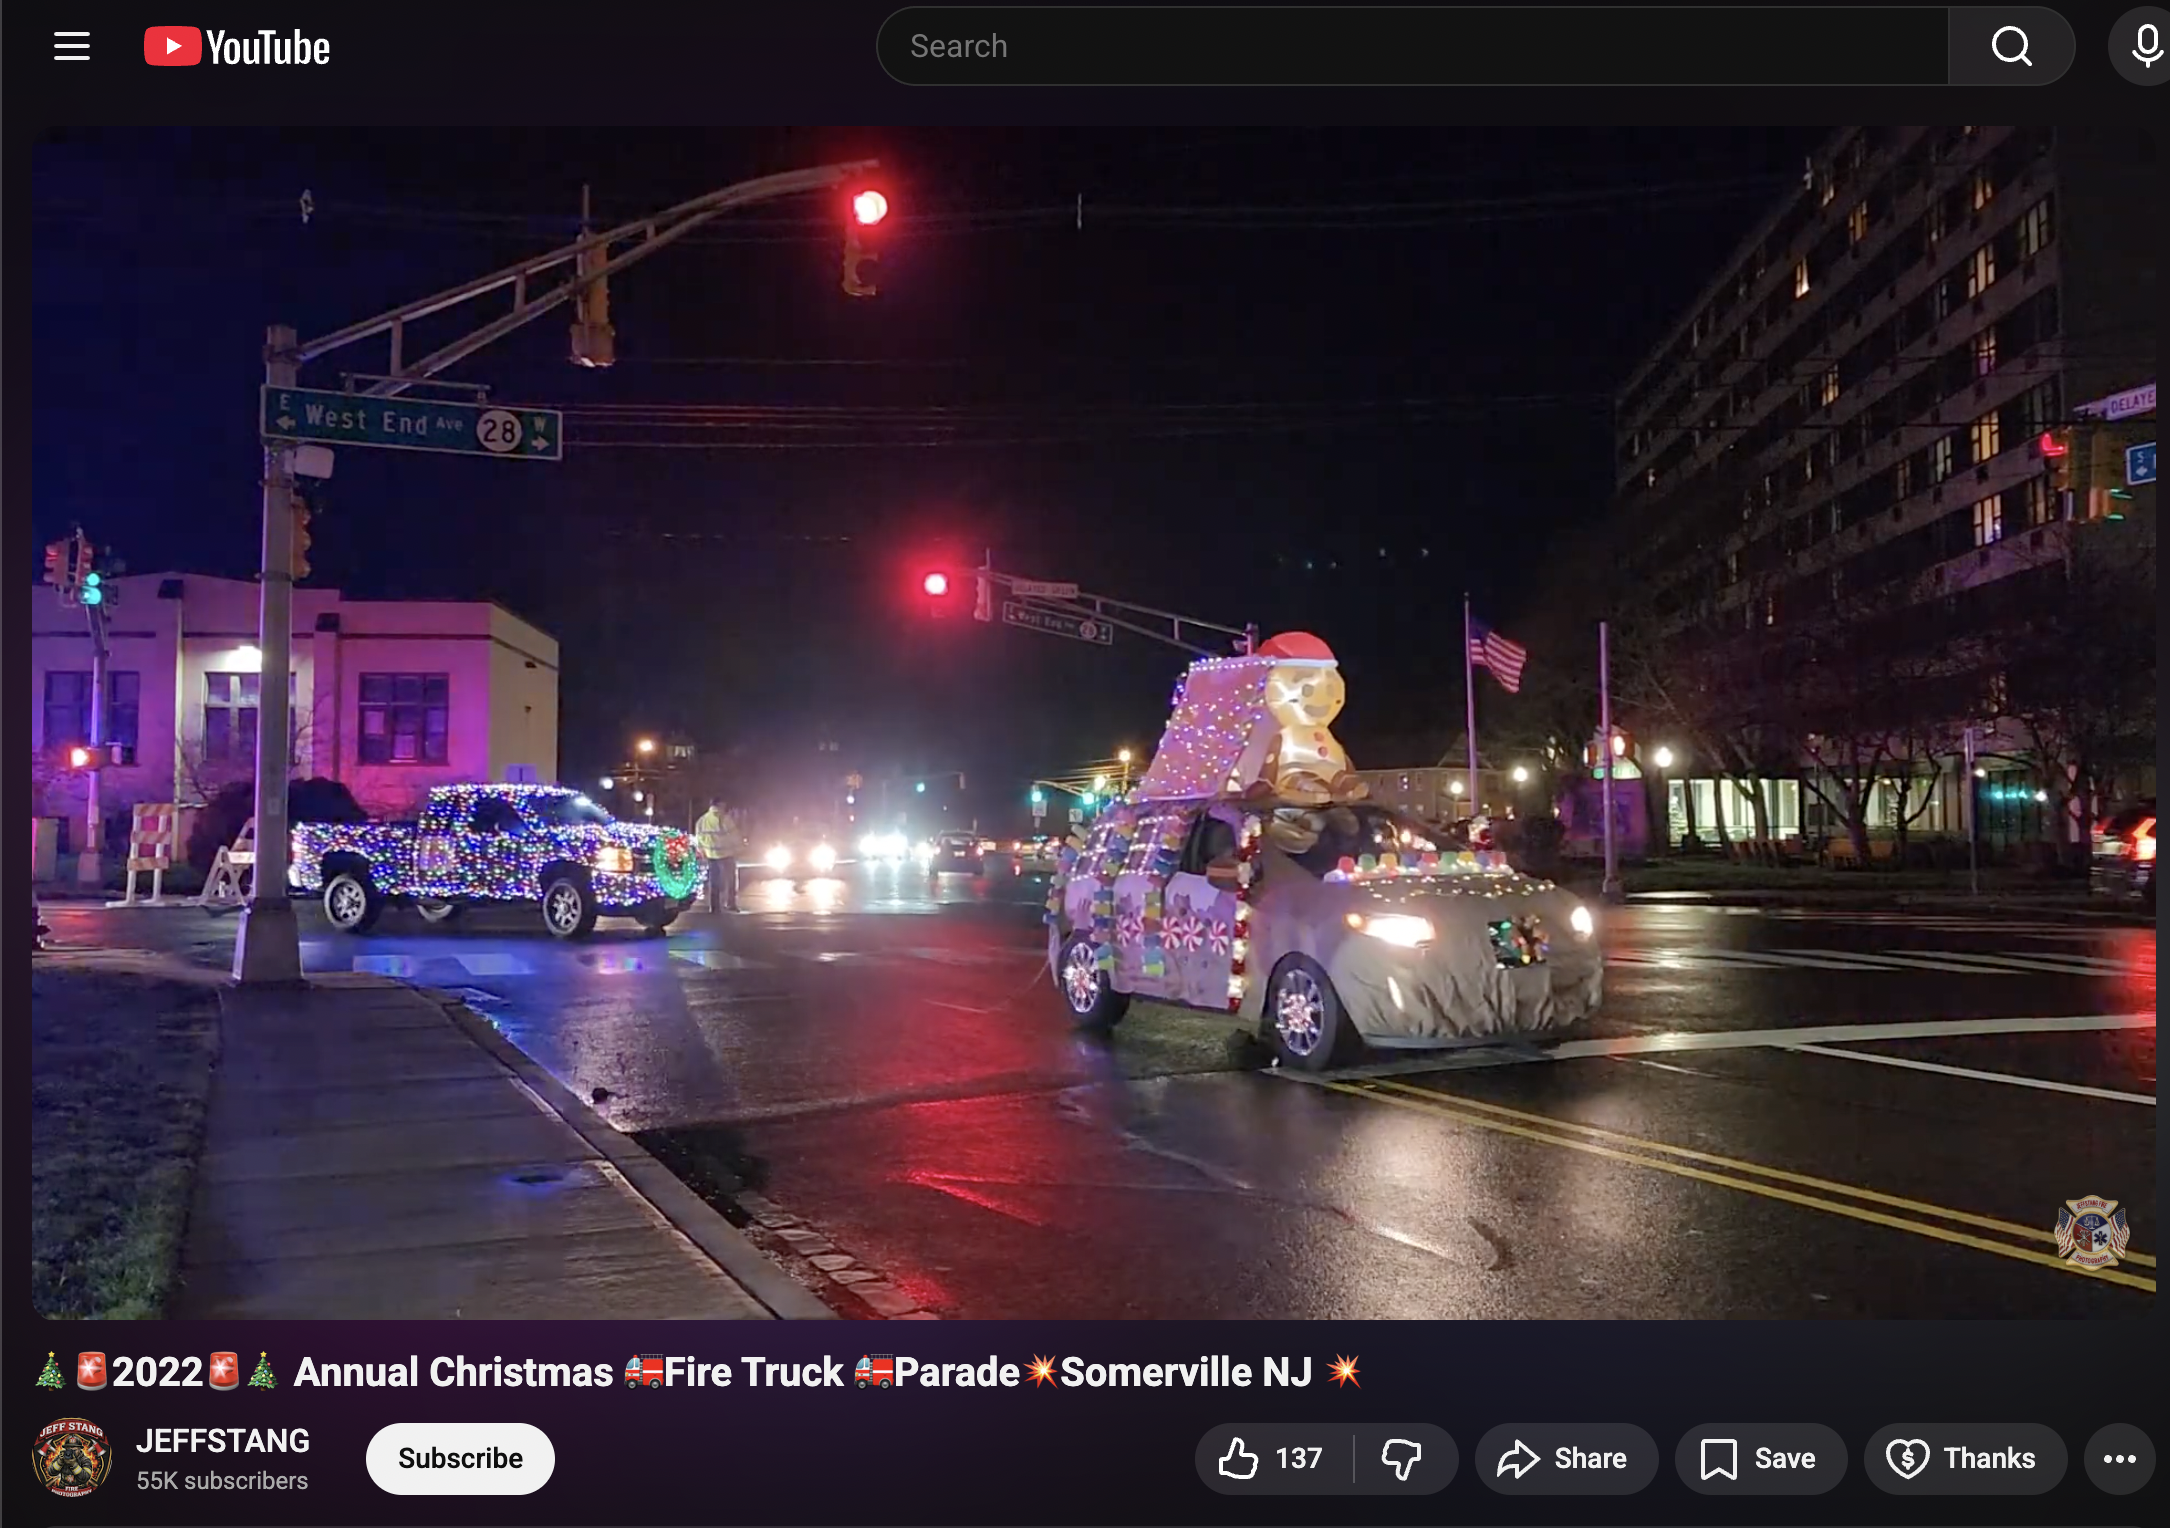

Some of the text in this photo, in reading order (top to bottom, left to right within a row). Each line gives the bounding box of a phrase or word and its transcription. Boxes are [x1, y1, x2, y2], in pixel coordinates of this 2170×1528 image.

[206, 29, 330, 65] YouTube
[911, 33, 1006, 57] Search
[280, 394, 291, 411] E
[305, 404, 516, 443] West End Ave 28
[534, 417, 546, 431] W
[113, 1355, 1311, 1388] 2022 Annual Christmas Fire Truck Parade Somerville NJ
[40, 1422, 103, 1437] JEFF STANG
[136, 1428, 309, 1453] JEFFSTANG
[398, 1446, 523, 1469] Subscribe
[1276, 1447, 1323, 1469] 137
[1555, 1446, 1627, 1469] Share
[1756, 1446, 1816, 1469] Save
[1944, 1446, 2036, 1469] Thanks
[137, 1470, 308, 1490] 55K subscribers
